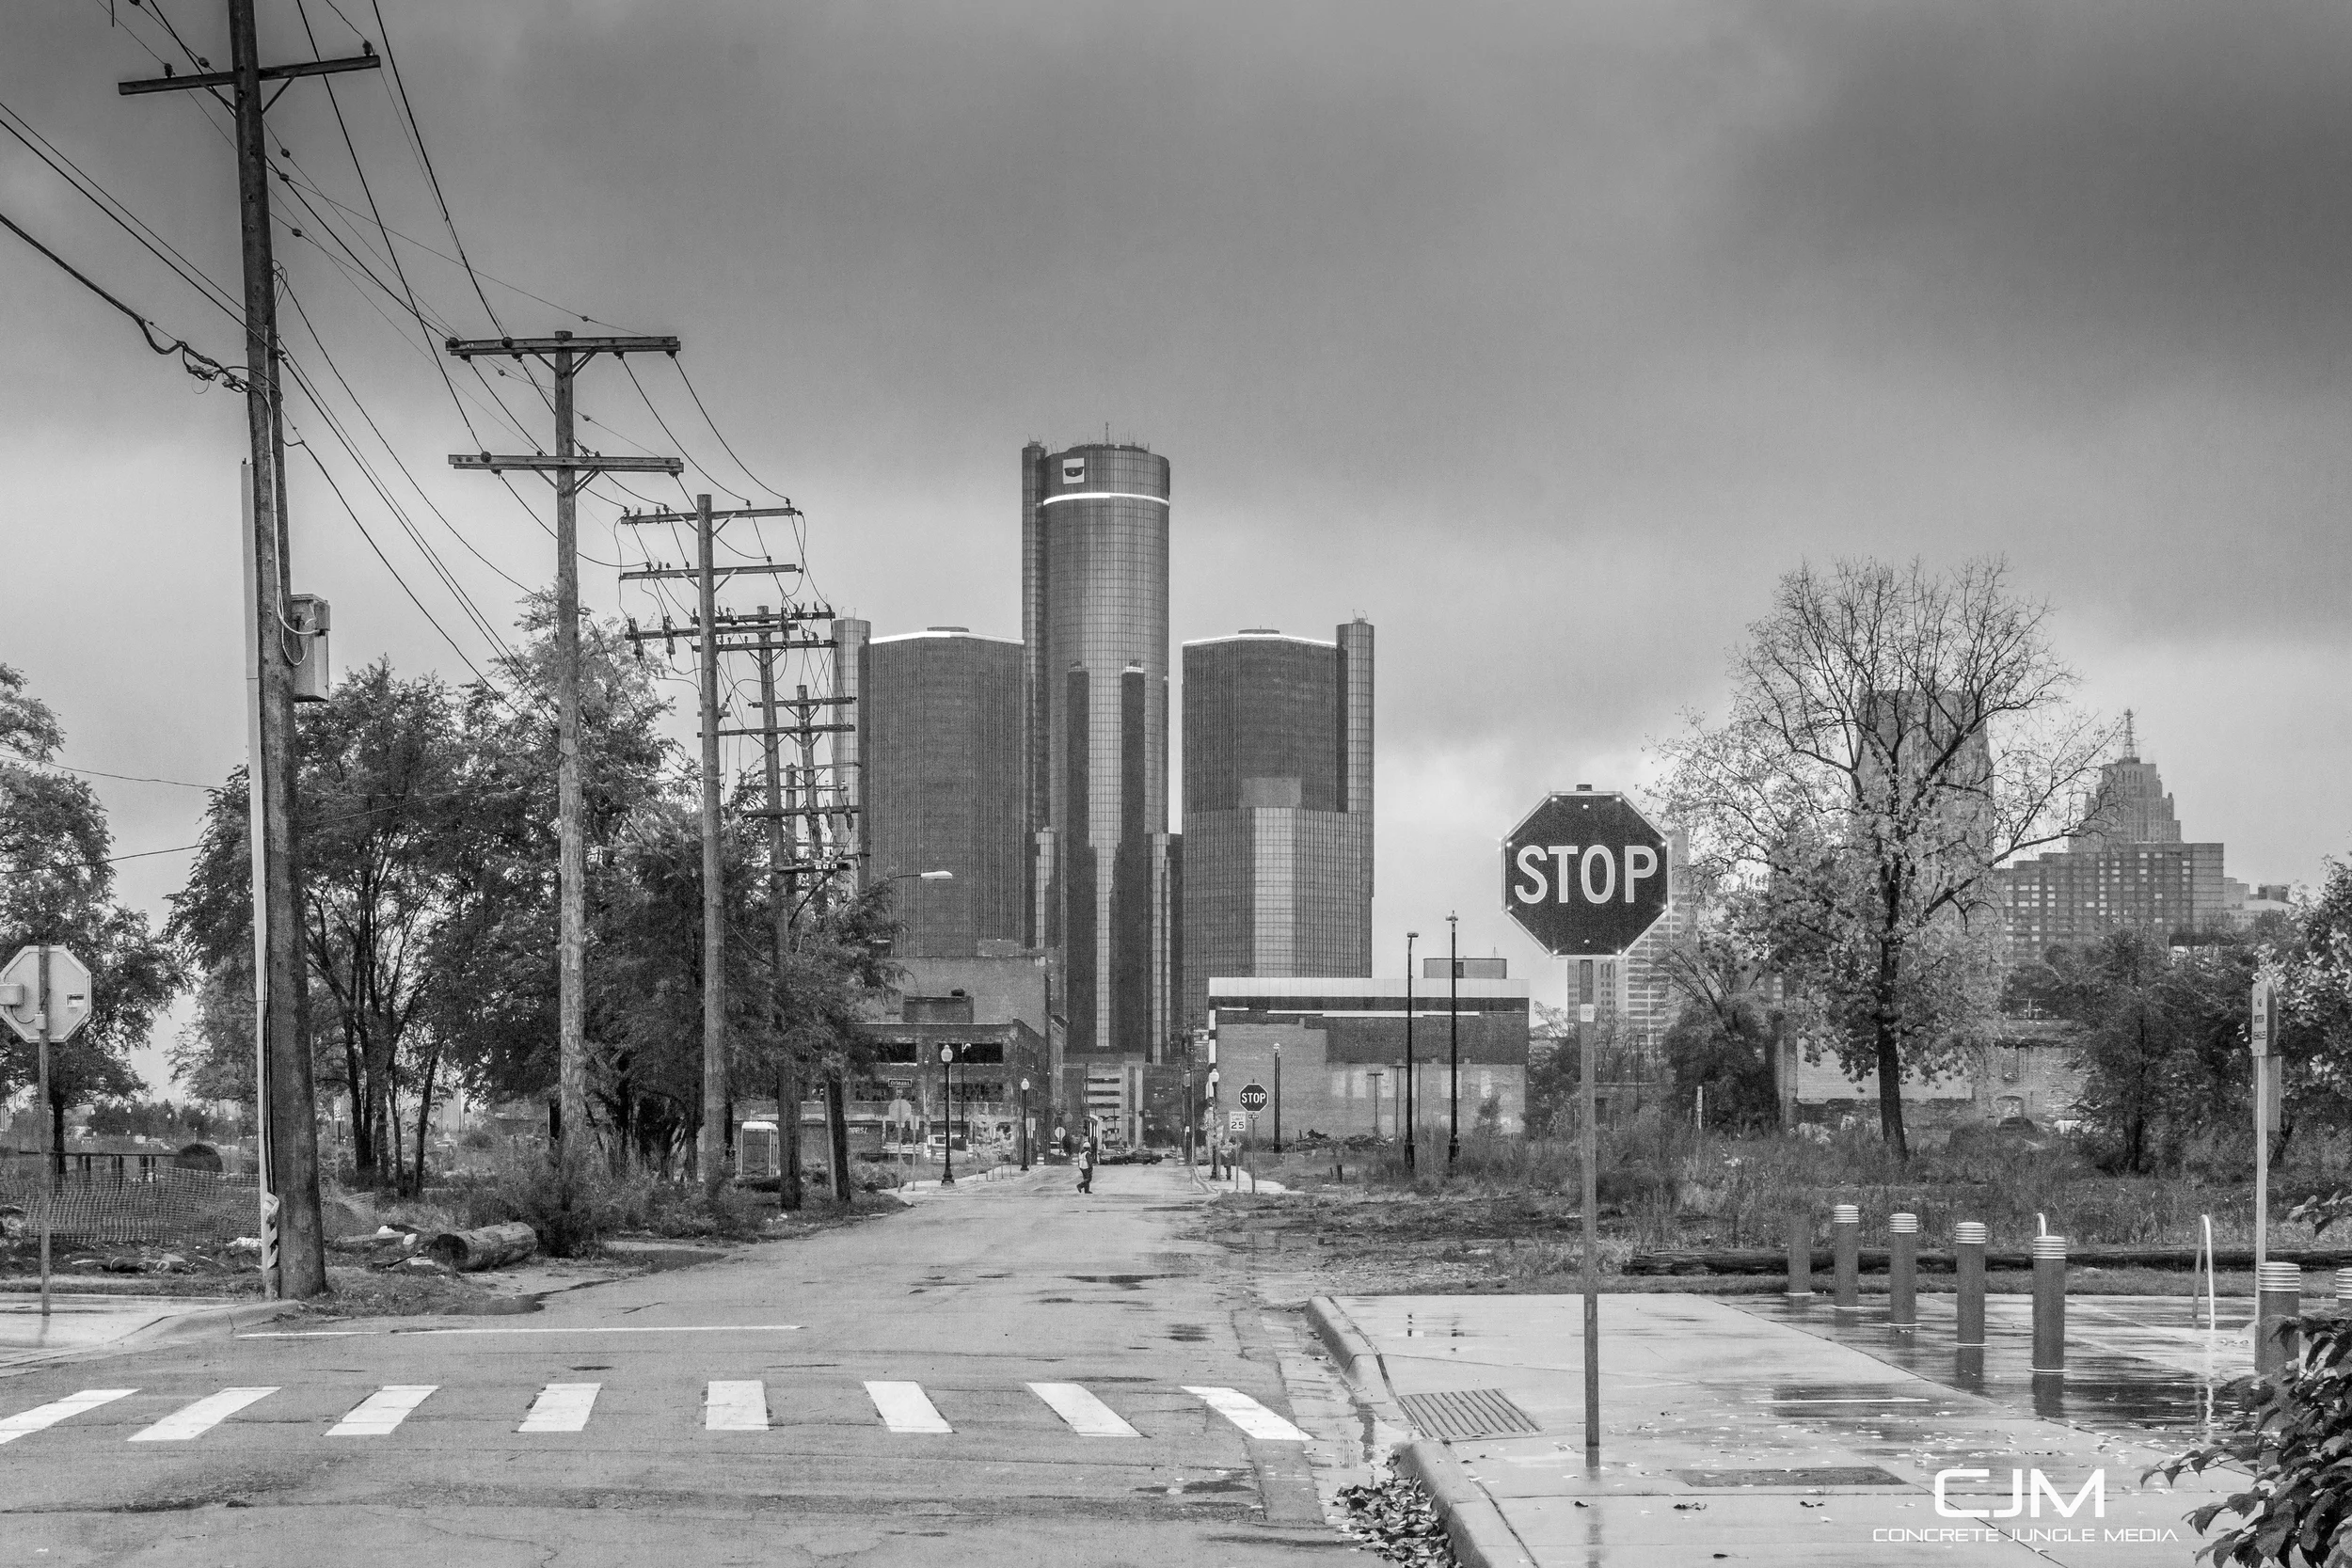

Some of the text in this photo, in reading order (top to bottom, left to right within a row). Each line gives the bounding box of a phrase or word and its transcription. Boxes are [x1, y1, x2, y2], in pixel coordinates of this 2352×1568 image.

[1515, 845, 1658, 904] STOP
[1241, 1093, 1266, 1103] STOP
[1231, 1121, 1245, 1130] 25
